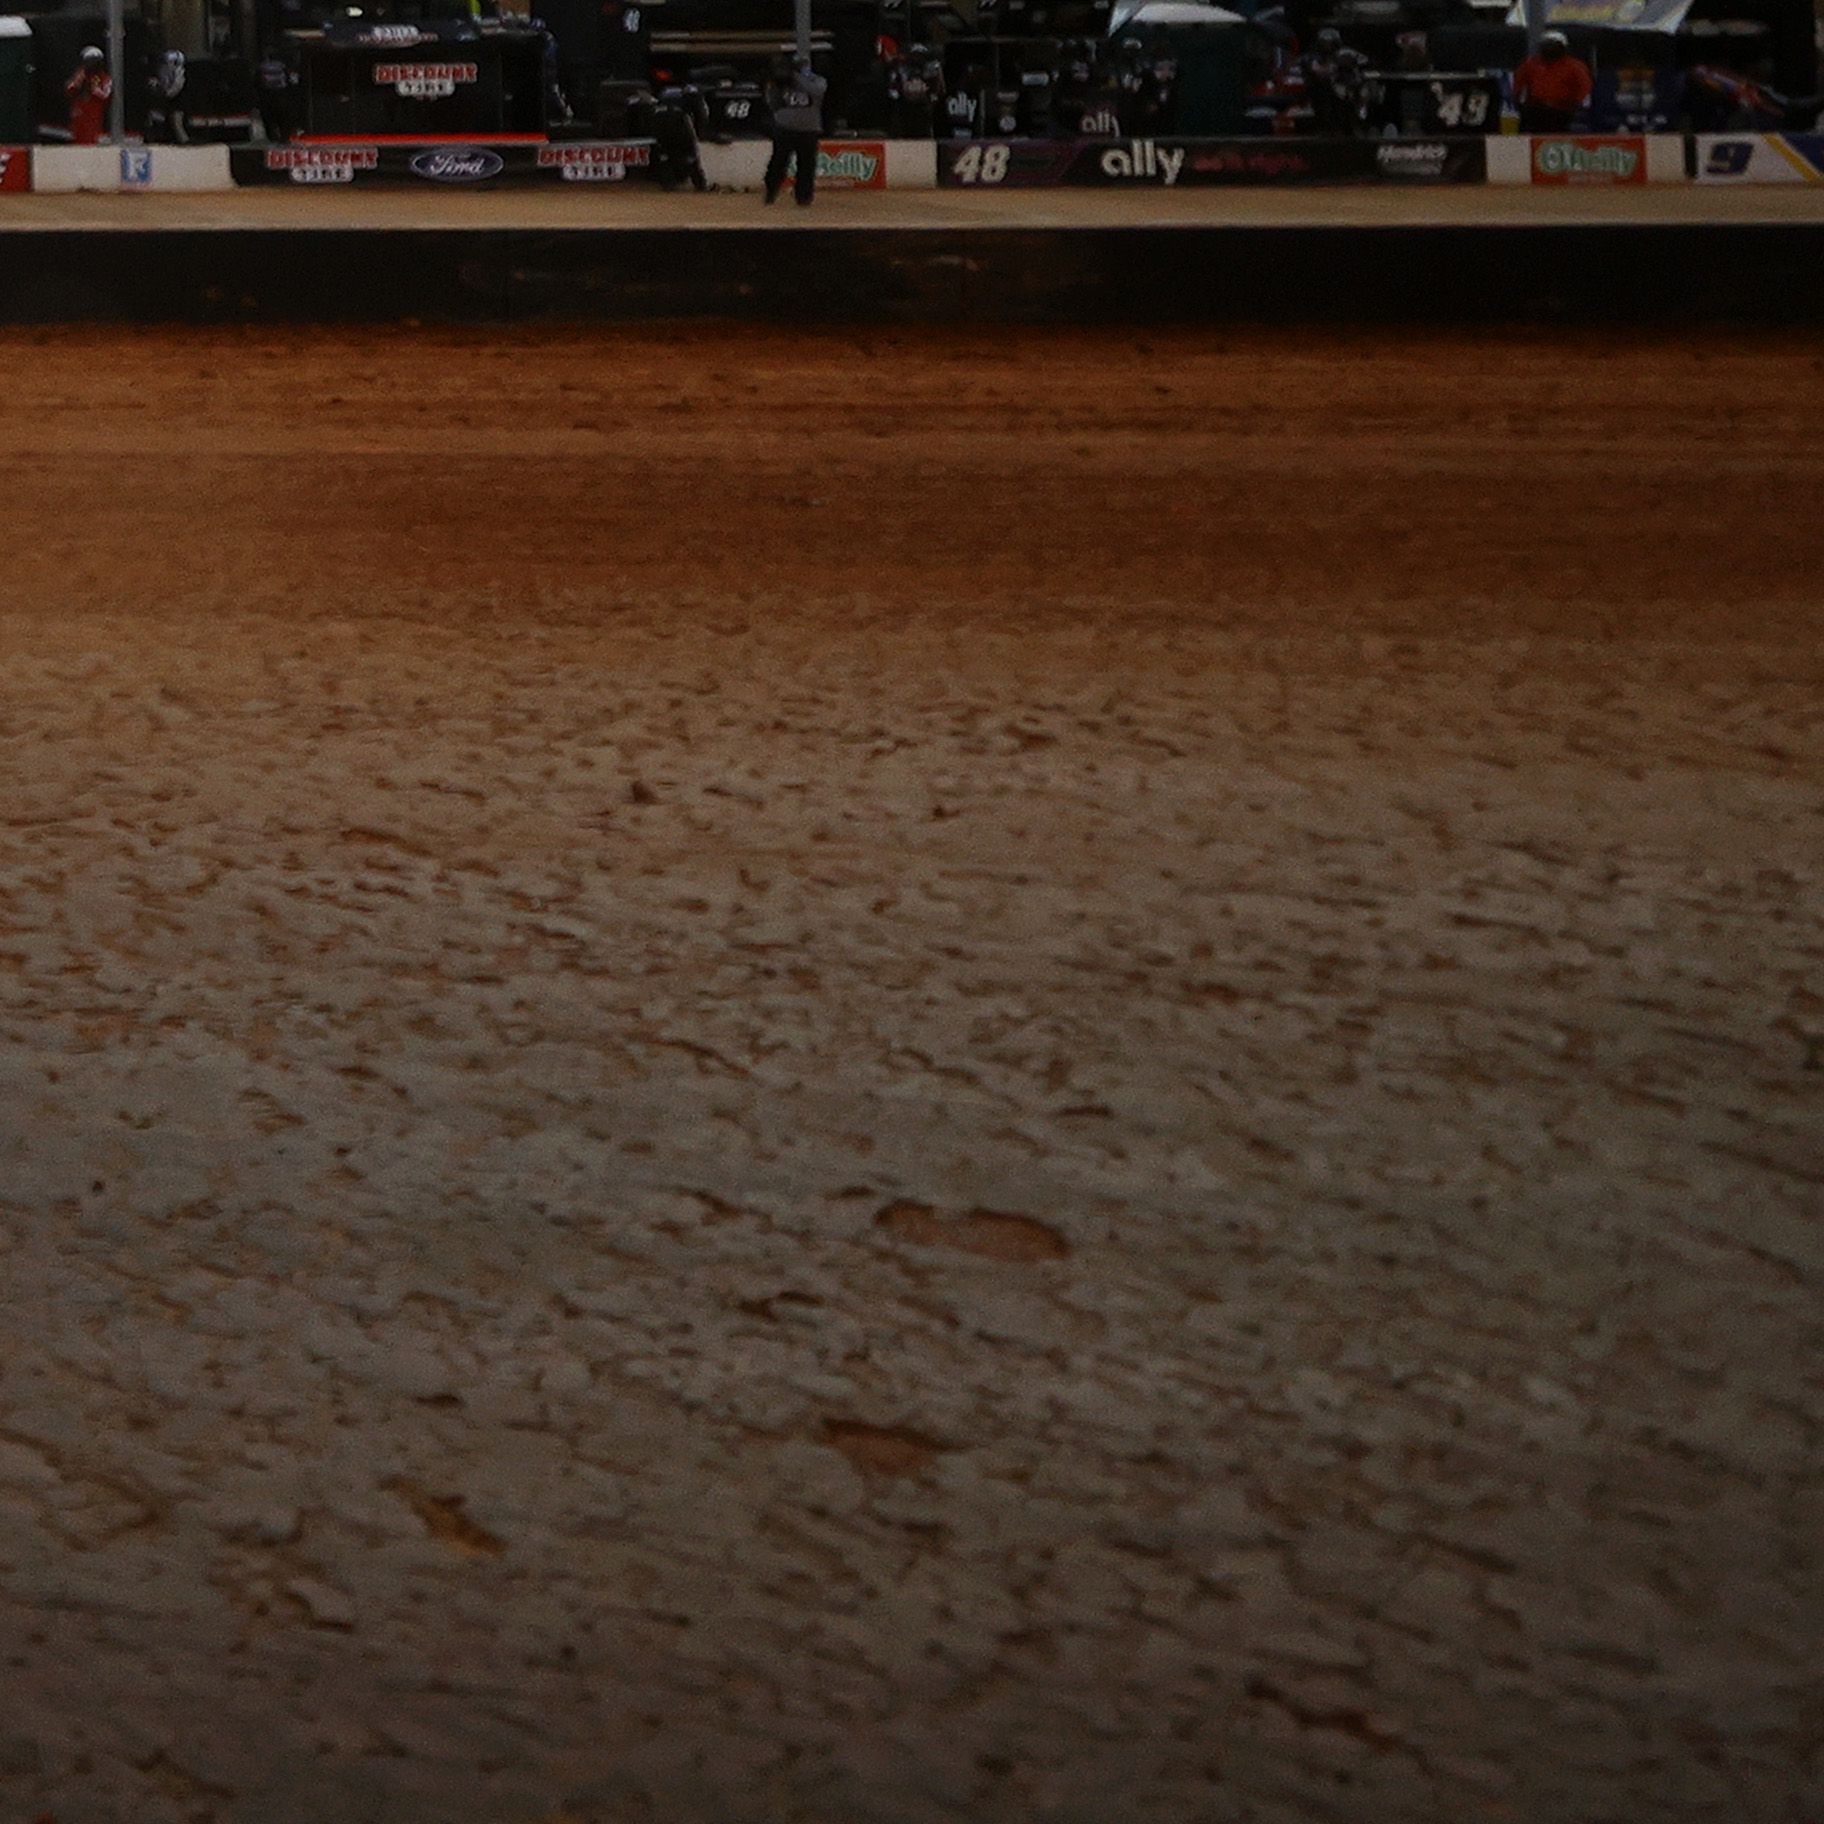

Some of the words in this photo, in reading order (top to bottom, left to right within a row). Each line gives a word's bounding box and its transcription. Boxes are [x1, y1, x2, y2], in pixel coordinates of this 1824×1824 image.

[375, 62, 480, 83] DISCOUNT
[725, 99, 752, 121] 48
[947, 90, 978, 124] ally
[1079, 107, 1120, 138] ally
[267, 148, 380, 169] DISCOUNT
[428, 151, 486, 175] Ford
[537, 146, 652, 167] DISCOUNT
[953, 142, 1011, 183] 48
[1102, 138, 1186, 185] ally
[1706, 141, 1754, 175] 9
